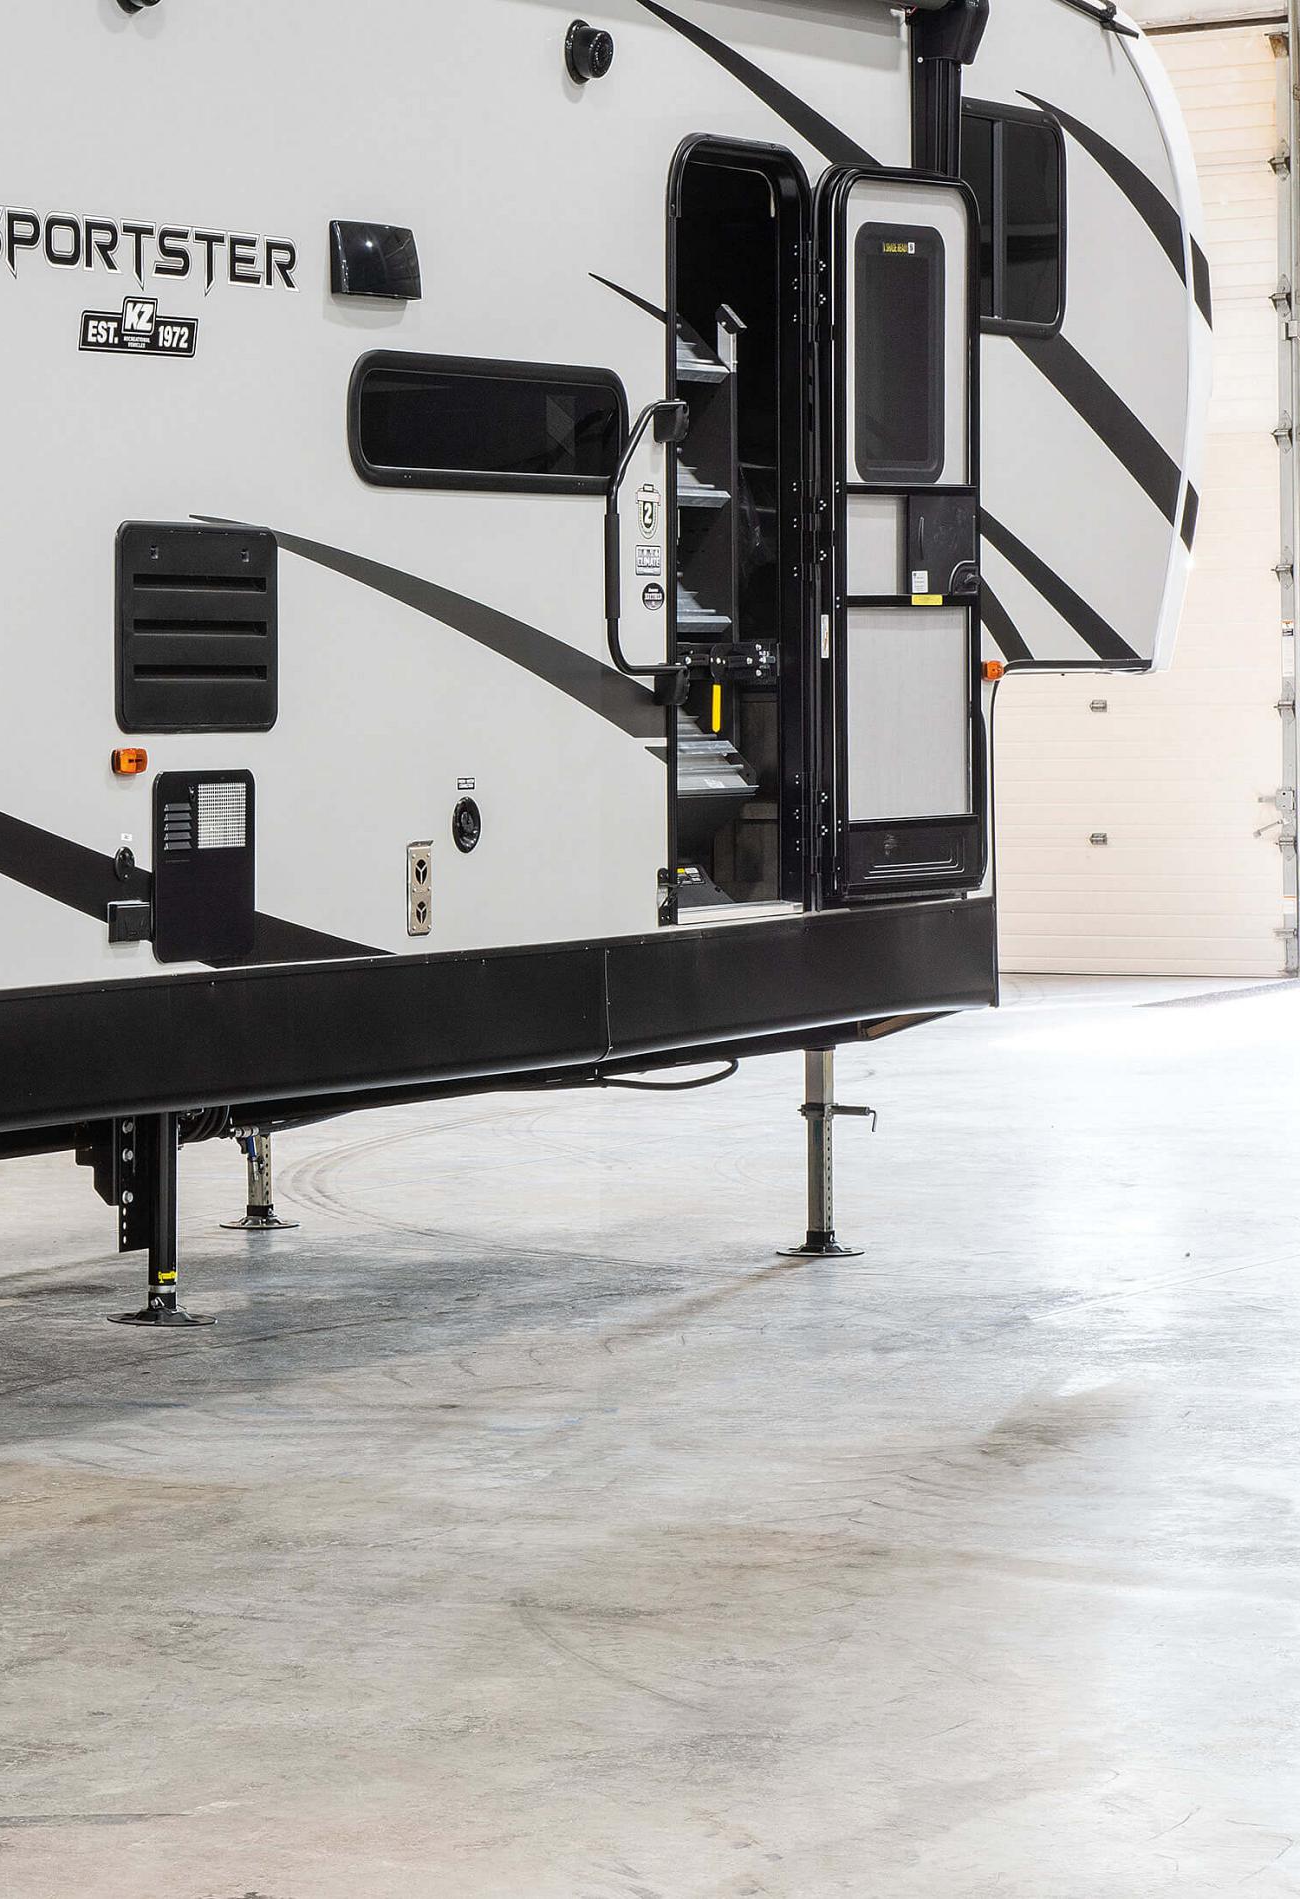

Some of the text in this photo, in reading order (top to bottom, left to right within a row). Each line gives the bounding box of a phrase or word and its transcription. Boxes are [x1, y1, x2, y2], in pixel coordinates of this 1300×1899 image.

[87, 302, 189, 349] EST. KZ 1972
[644, 502, 652, 524] 2
